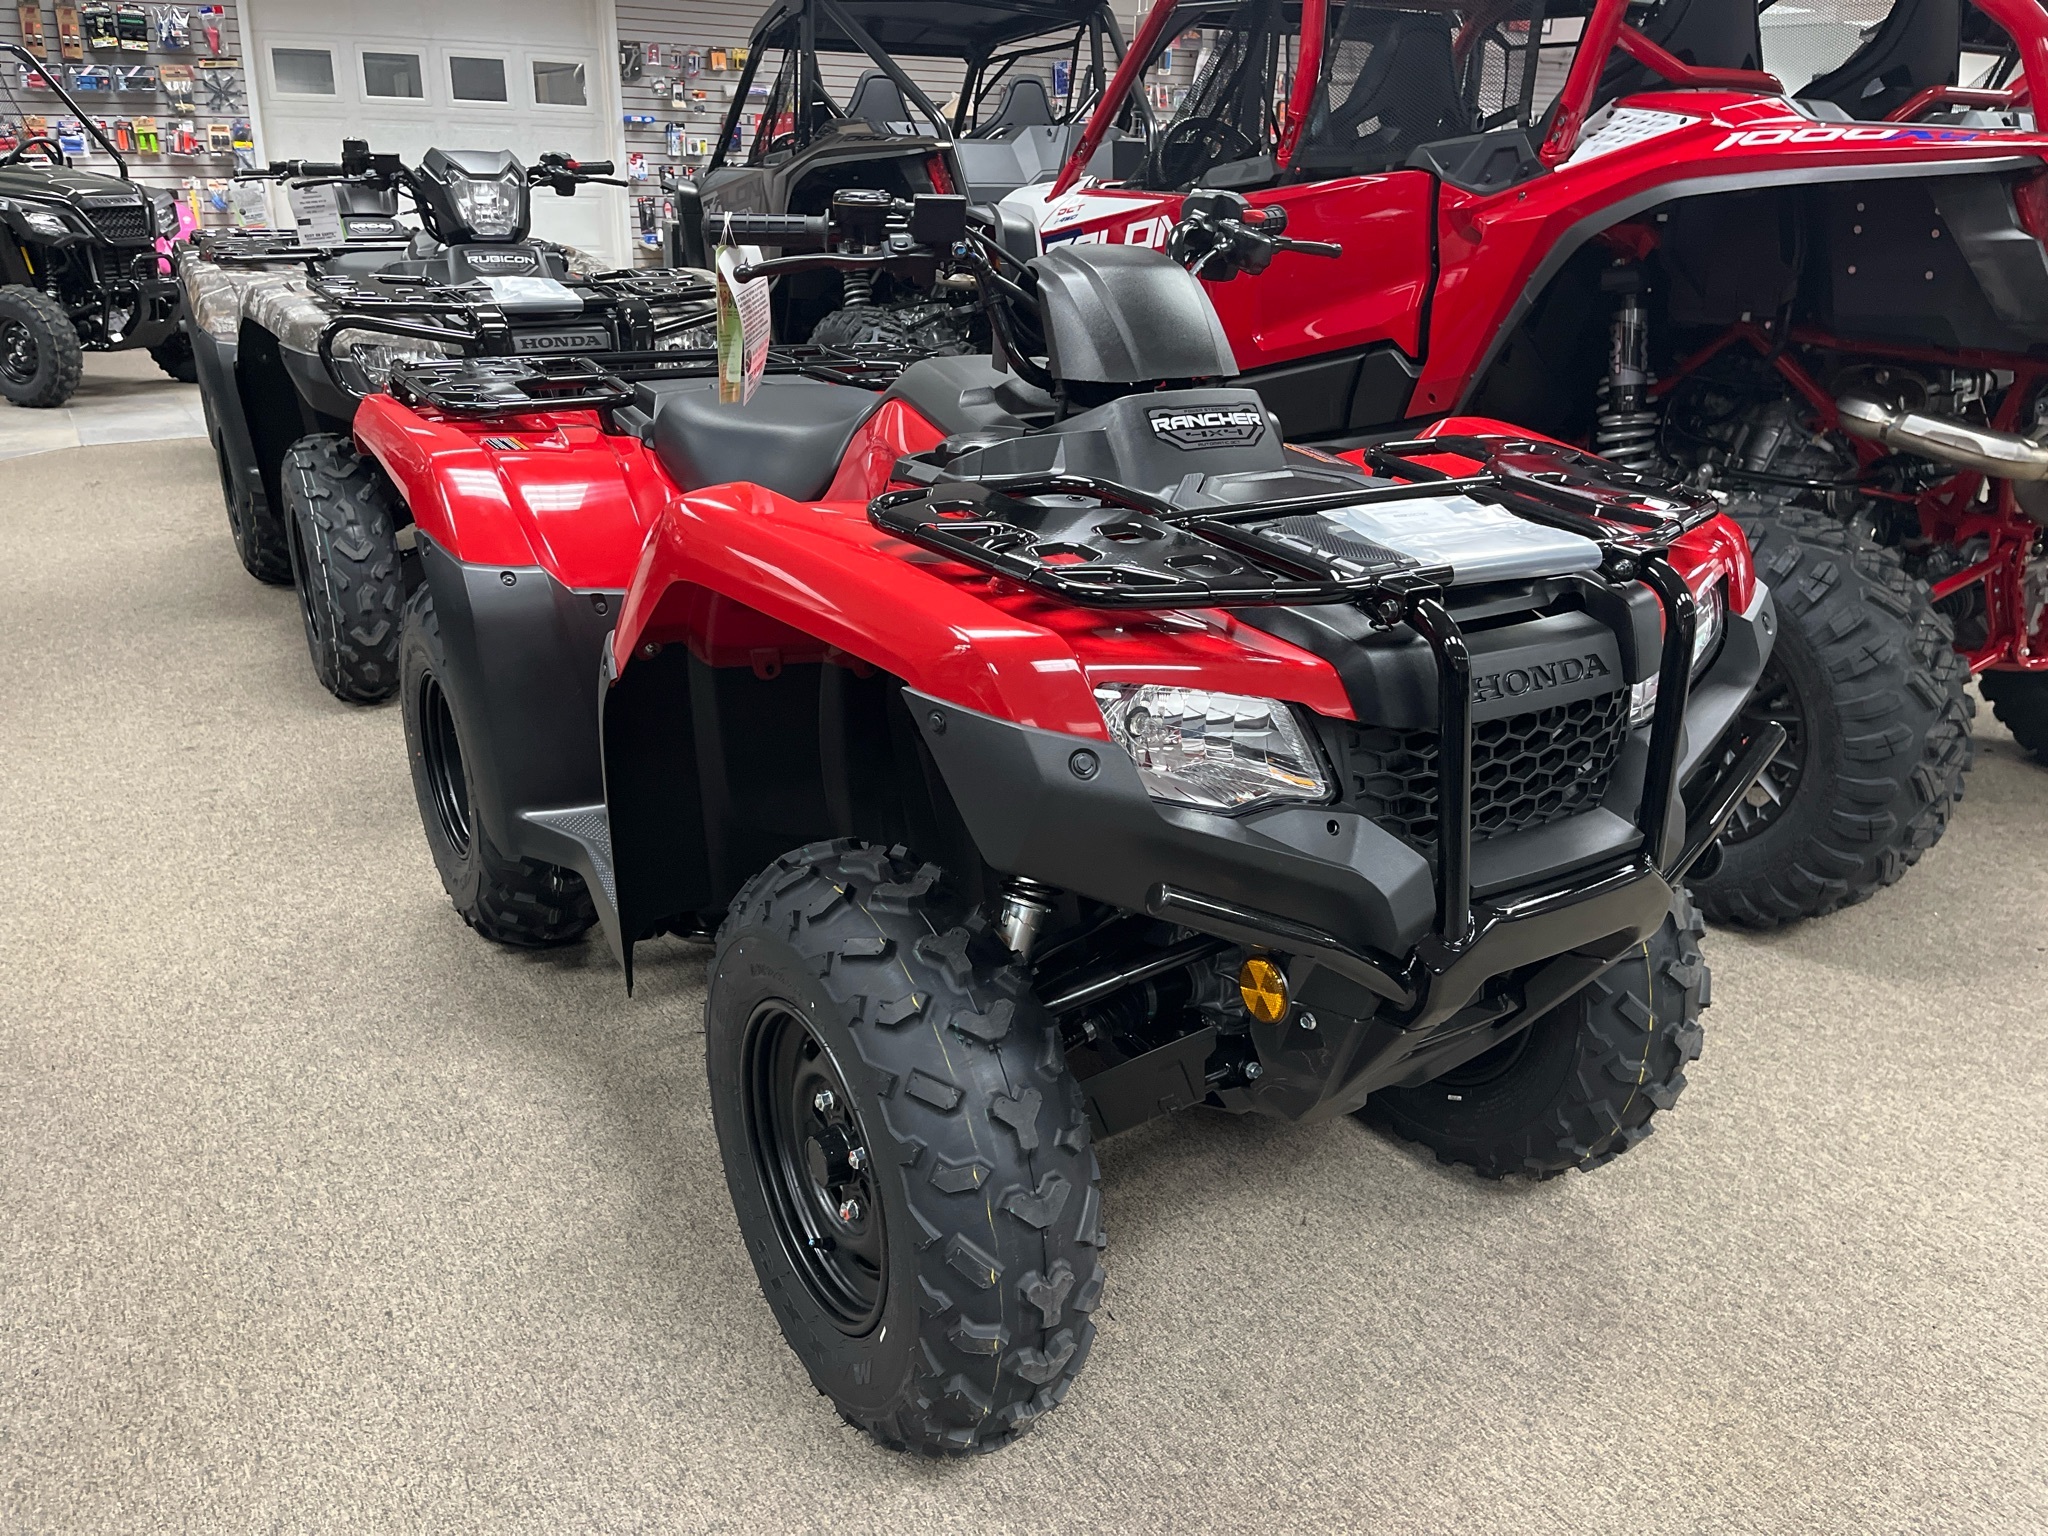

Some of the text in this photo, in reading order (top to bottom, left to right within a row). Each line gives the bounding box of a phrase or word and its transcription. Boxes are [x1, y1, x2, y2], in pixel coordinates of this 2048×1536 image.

[1057, 204, 1085, 216] DCT
[466, 255, 536, 265] RUBICON
[519, 336, 602, 350] HONDA
[1151, 412, 1263, 433] RANCHER
[1471, 653, 1611, 705] HONDA
